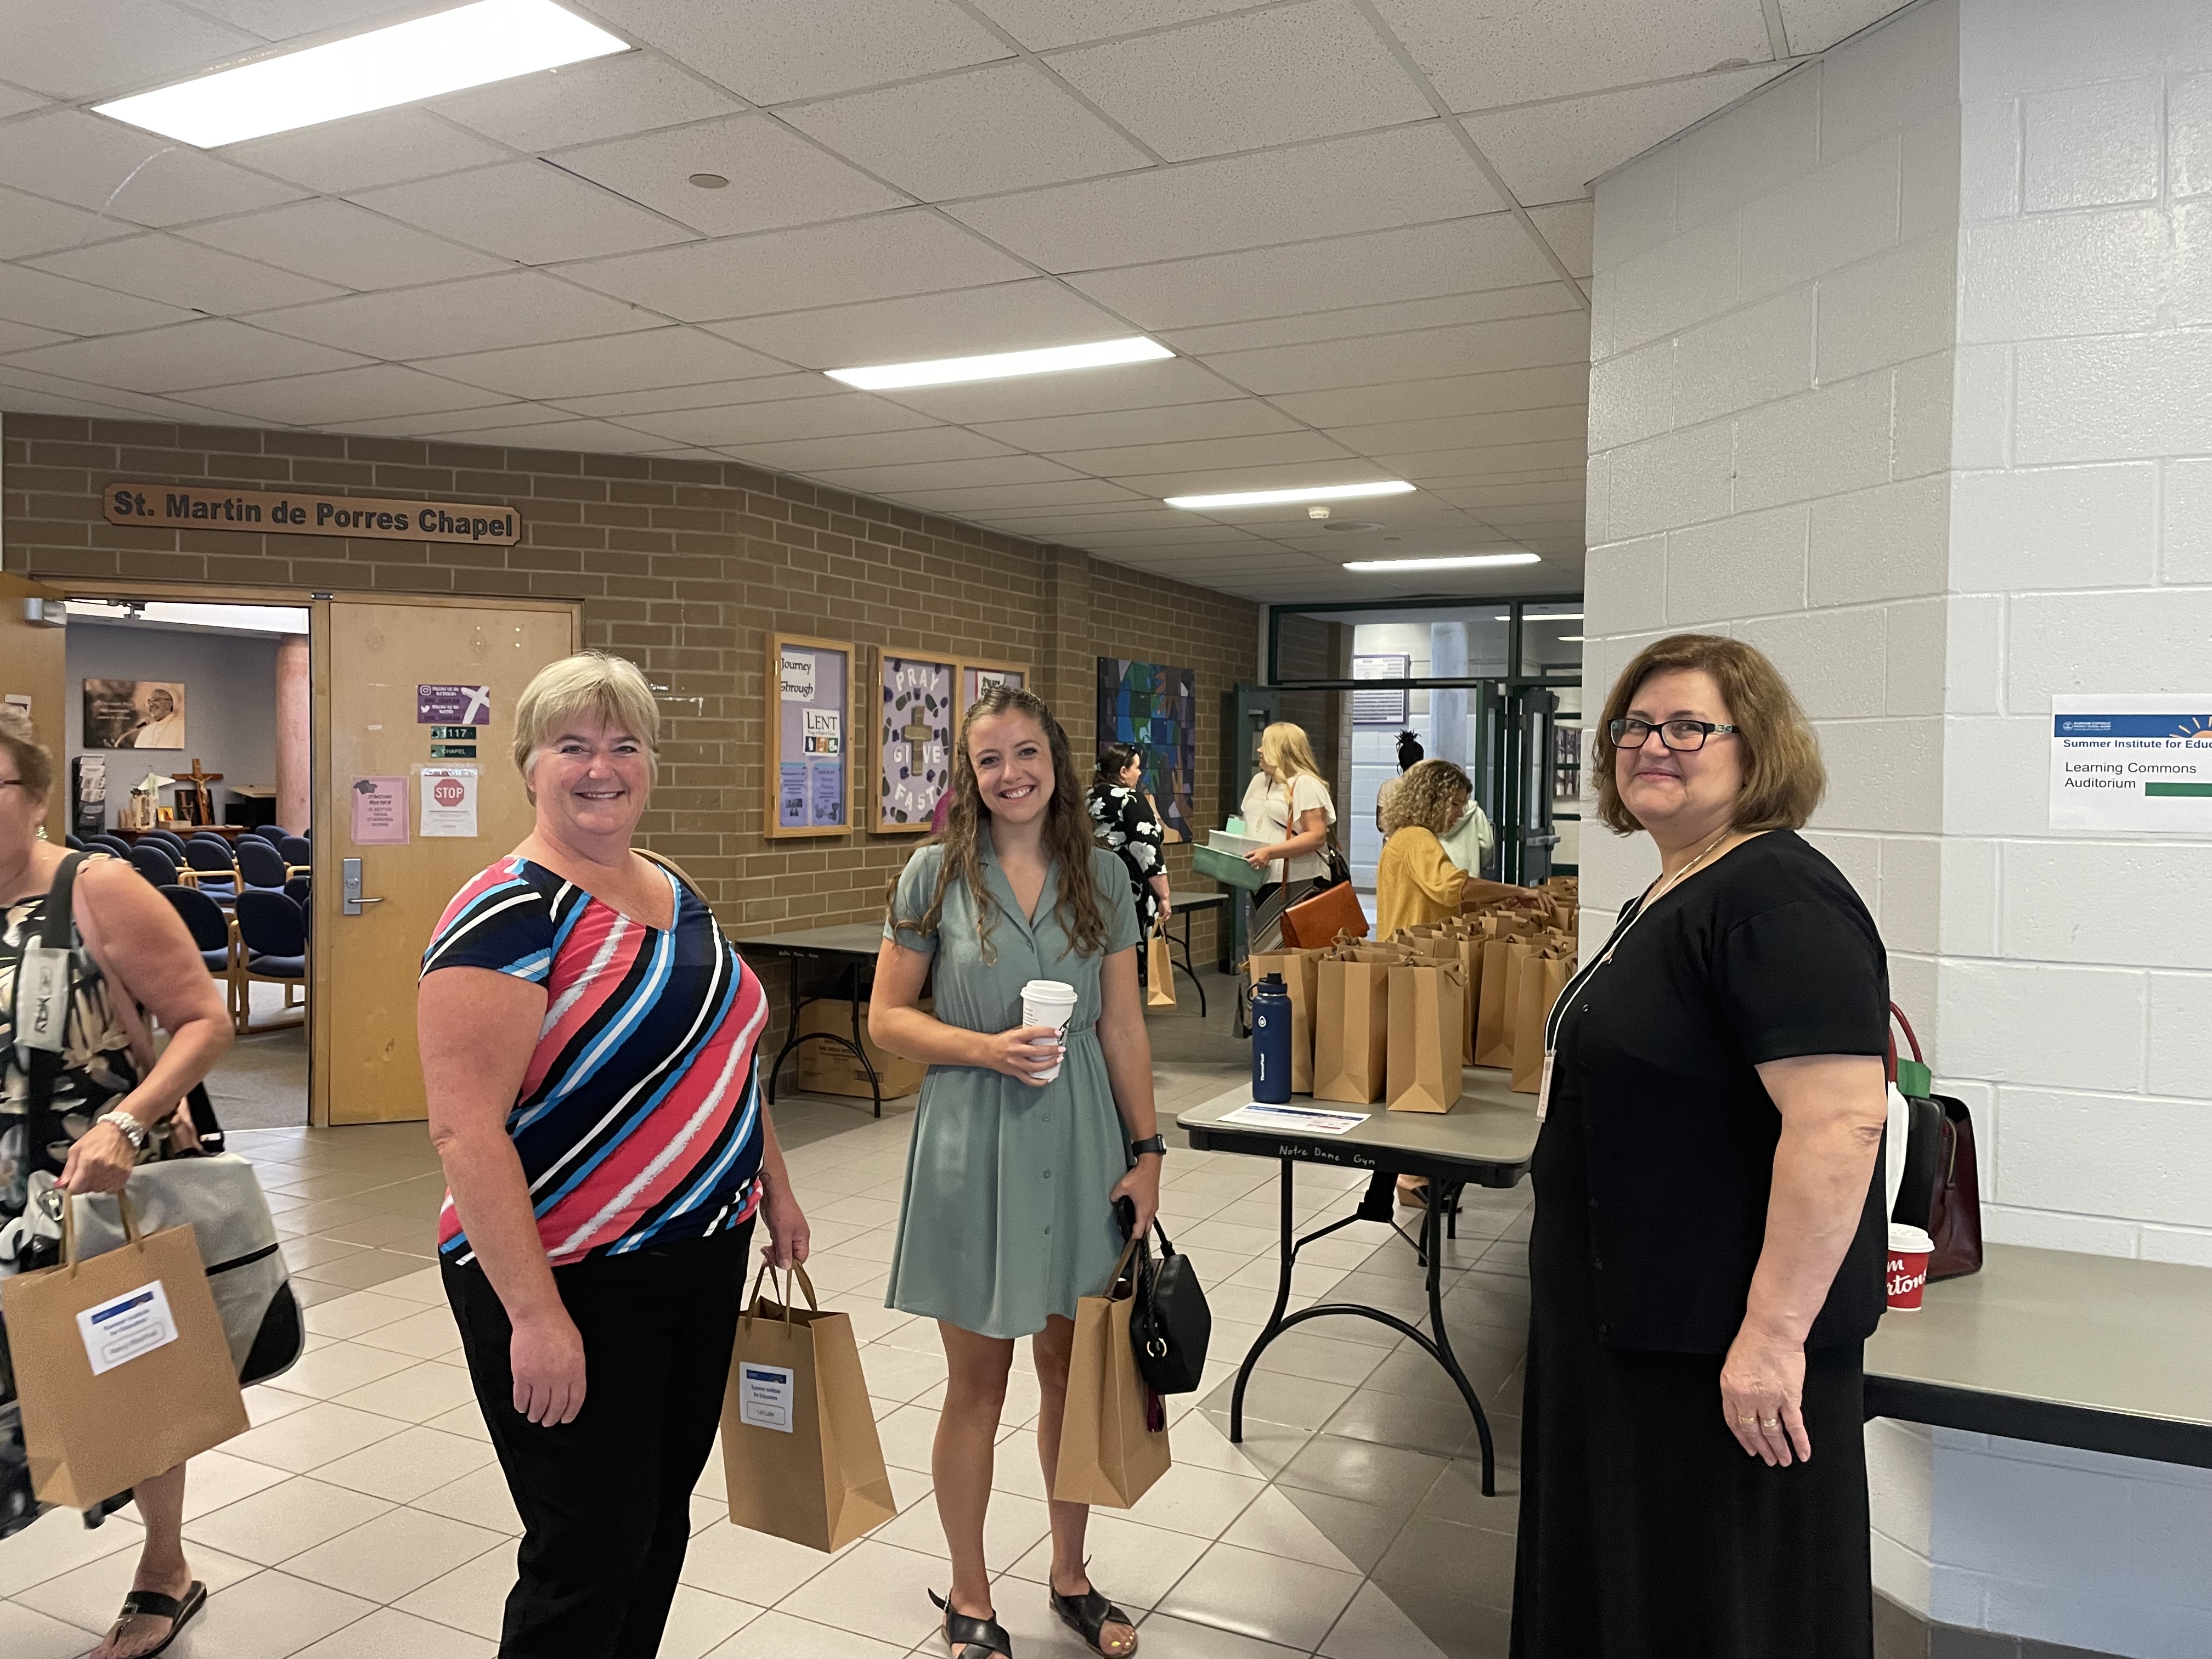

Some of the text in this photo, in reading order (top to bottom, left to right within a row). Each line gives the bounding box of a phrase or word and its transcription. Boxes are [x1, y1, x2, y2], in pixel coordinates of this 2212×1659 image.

[113, 490, 512, 540] St. Martin de Porres Chapel
[781, 658, 811, 675] Journey
[895, 668, 940, 691] PRAY
[2063, 739, 2112, 748] Summer
[2114, 740, 2162, 748] Institute
[2166, 740, 2182, 748] for
[2065, 761, 2197, 775] Learning Commons
[2064, 778, 2136, 789] Auditorium
[435, 787, 464, 799] STOP
[894, 782, 935, 811] FAST
[1279, 1145, 1308, 1156] Notre
[1314, 1147, 1340, 1161] Dame
